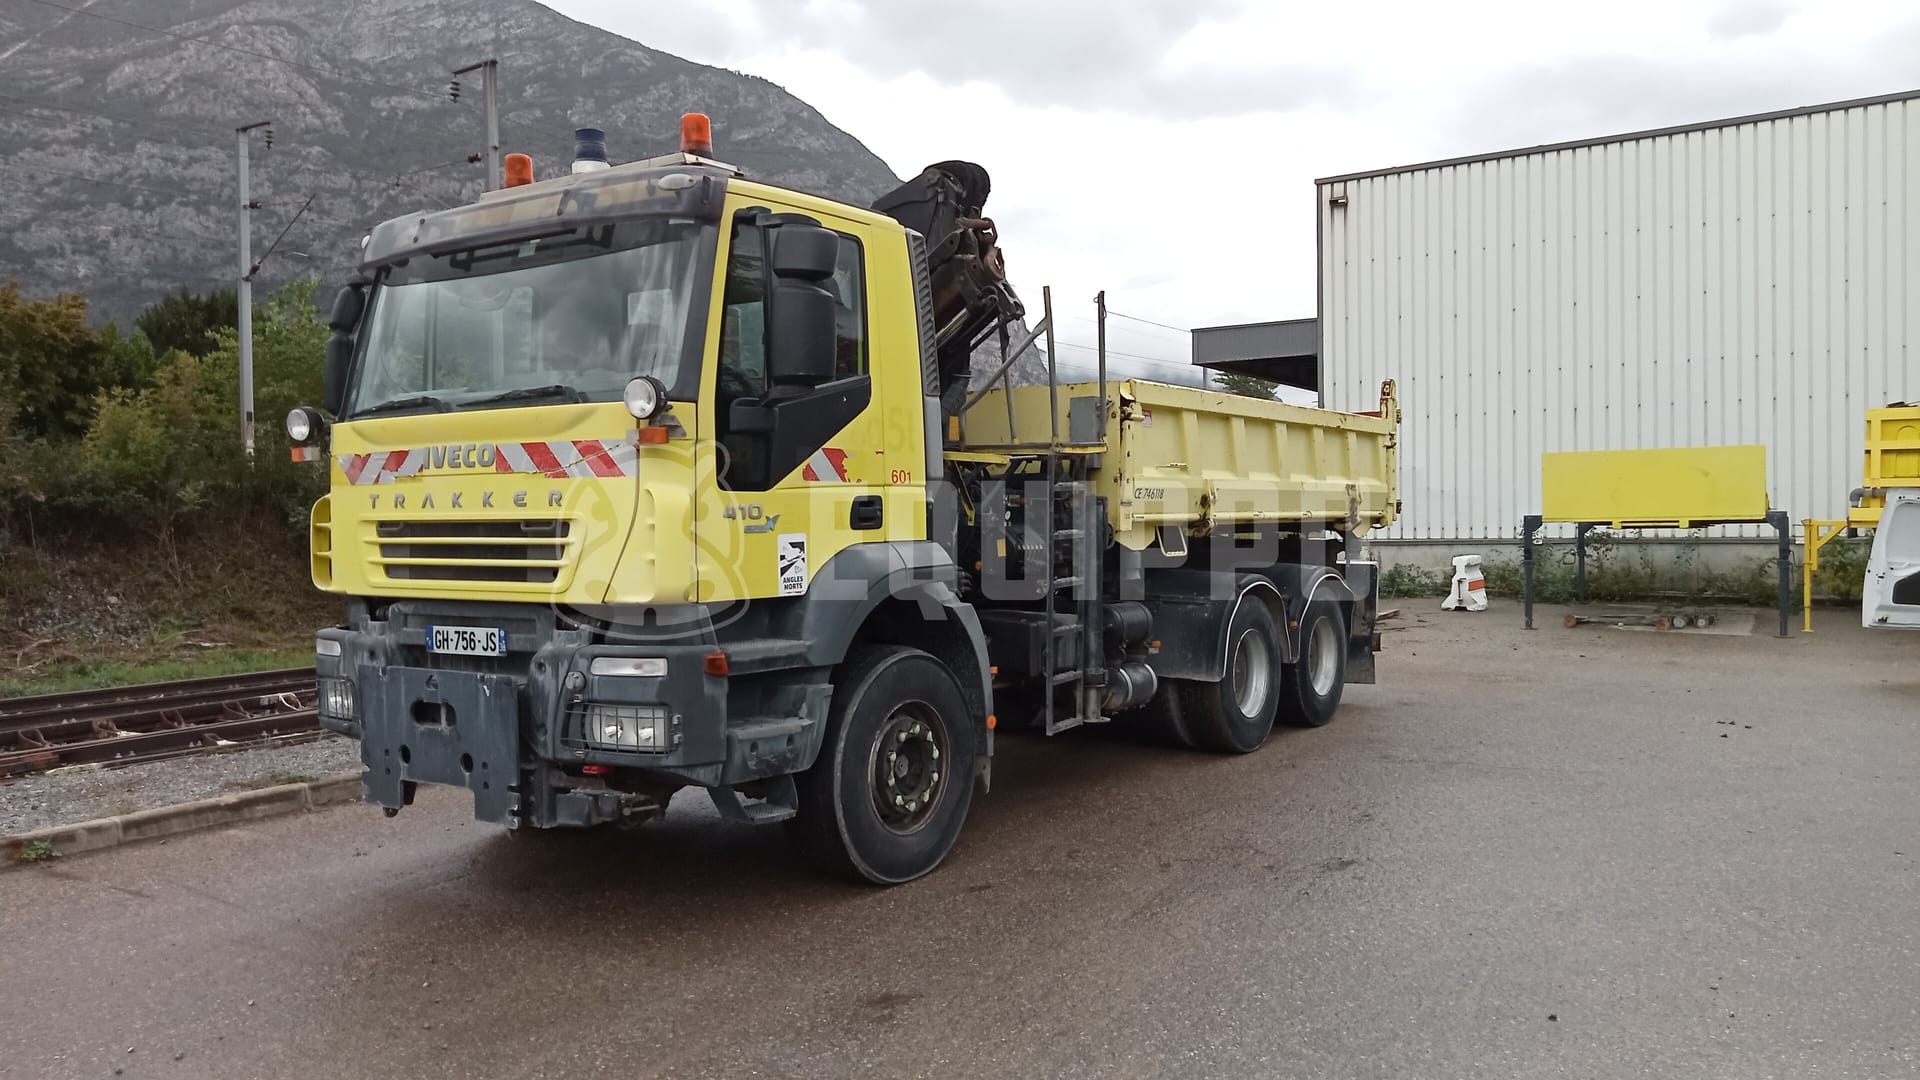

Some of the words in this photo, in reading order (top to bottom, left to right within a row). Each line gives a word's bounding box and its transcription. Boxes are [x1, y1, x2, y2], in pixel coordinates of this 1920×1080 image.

[423, 443, 496, 469] IVECO
[891, 470, 912, 485] 601
[369, 490, 565, 510] TRAKKER
[723, 503, 763, 520] 410
[783, 576, 804, 584] ANGLES
[435, 630, 497, 652] GH-756-JS
